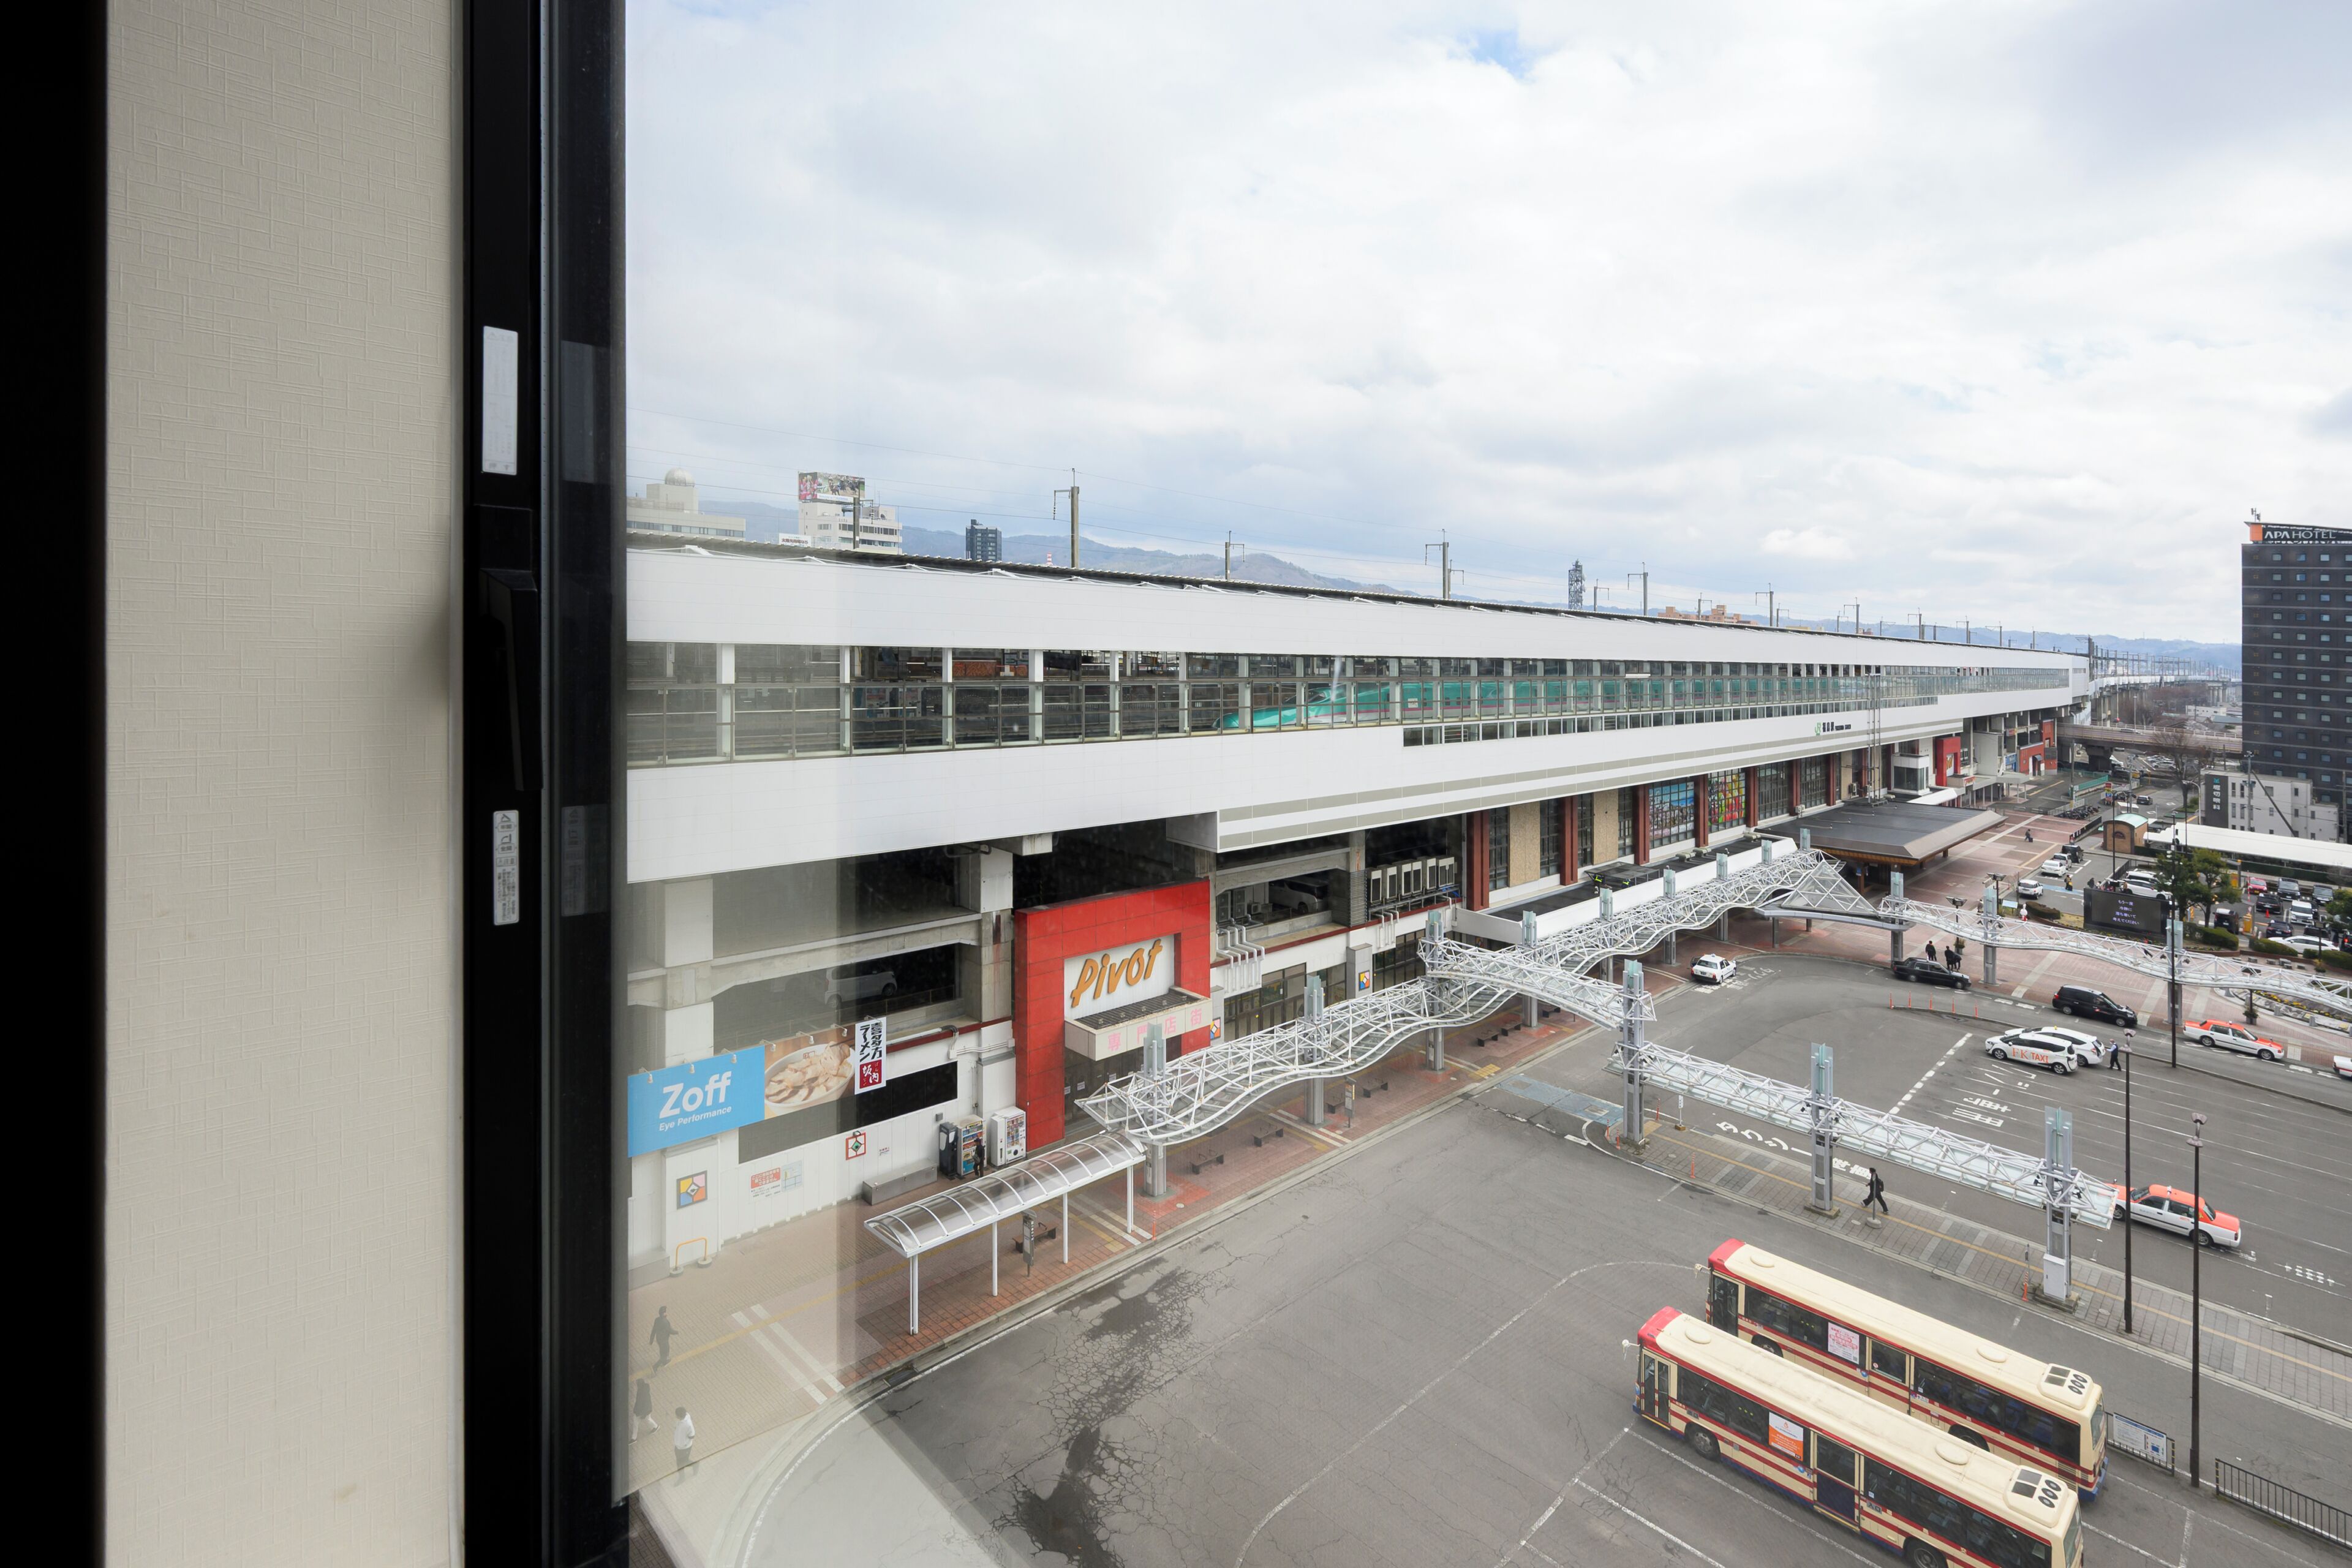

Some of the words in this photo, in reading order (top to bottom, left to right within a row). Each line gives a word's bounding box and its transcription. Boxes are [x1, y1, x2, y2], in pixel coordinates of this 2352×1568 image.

[2292, 530, 2337, 539] HOTEL
[1070, 938, 1164, 1008] Pivot
[859, 1024, 870, 1063] ラーメン
[871, 1022, 882, 1060] 喜多方
[2012, 1047, 2029, 1060] FK
[2031, 1052, 2049, 1064] TAXI
[862, 1064, 879, 1084] 坂内
[658, 1071, 733, 1119] Zoff
[658, 1121, 676, 1133] Eye
[677, 1106, 733, 1127] Performance
